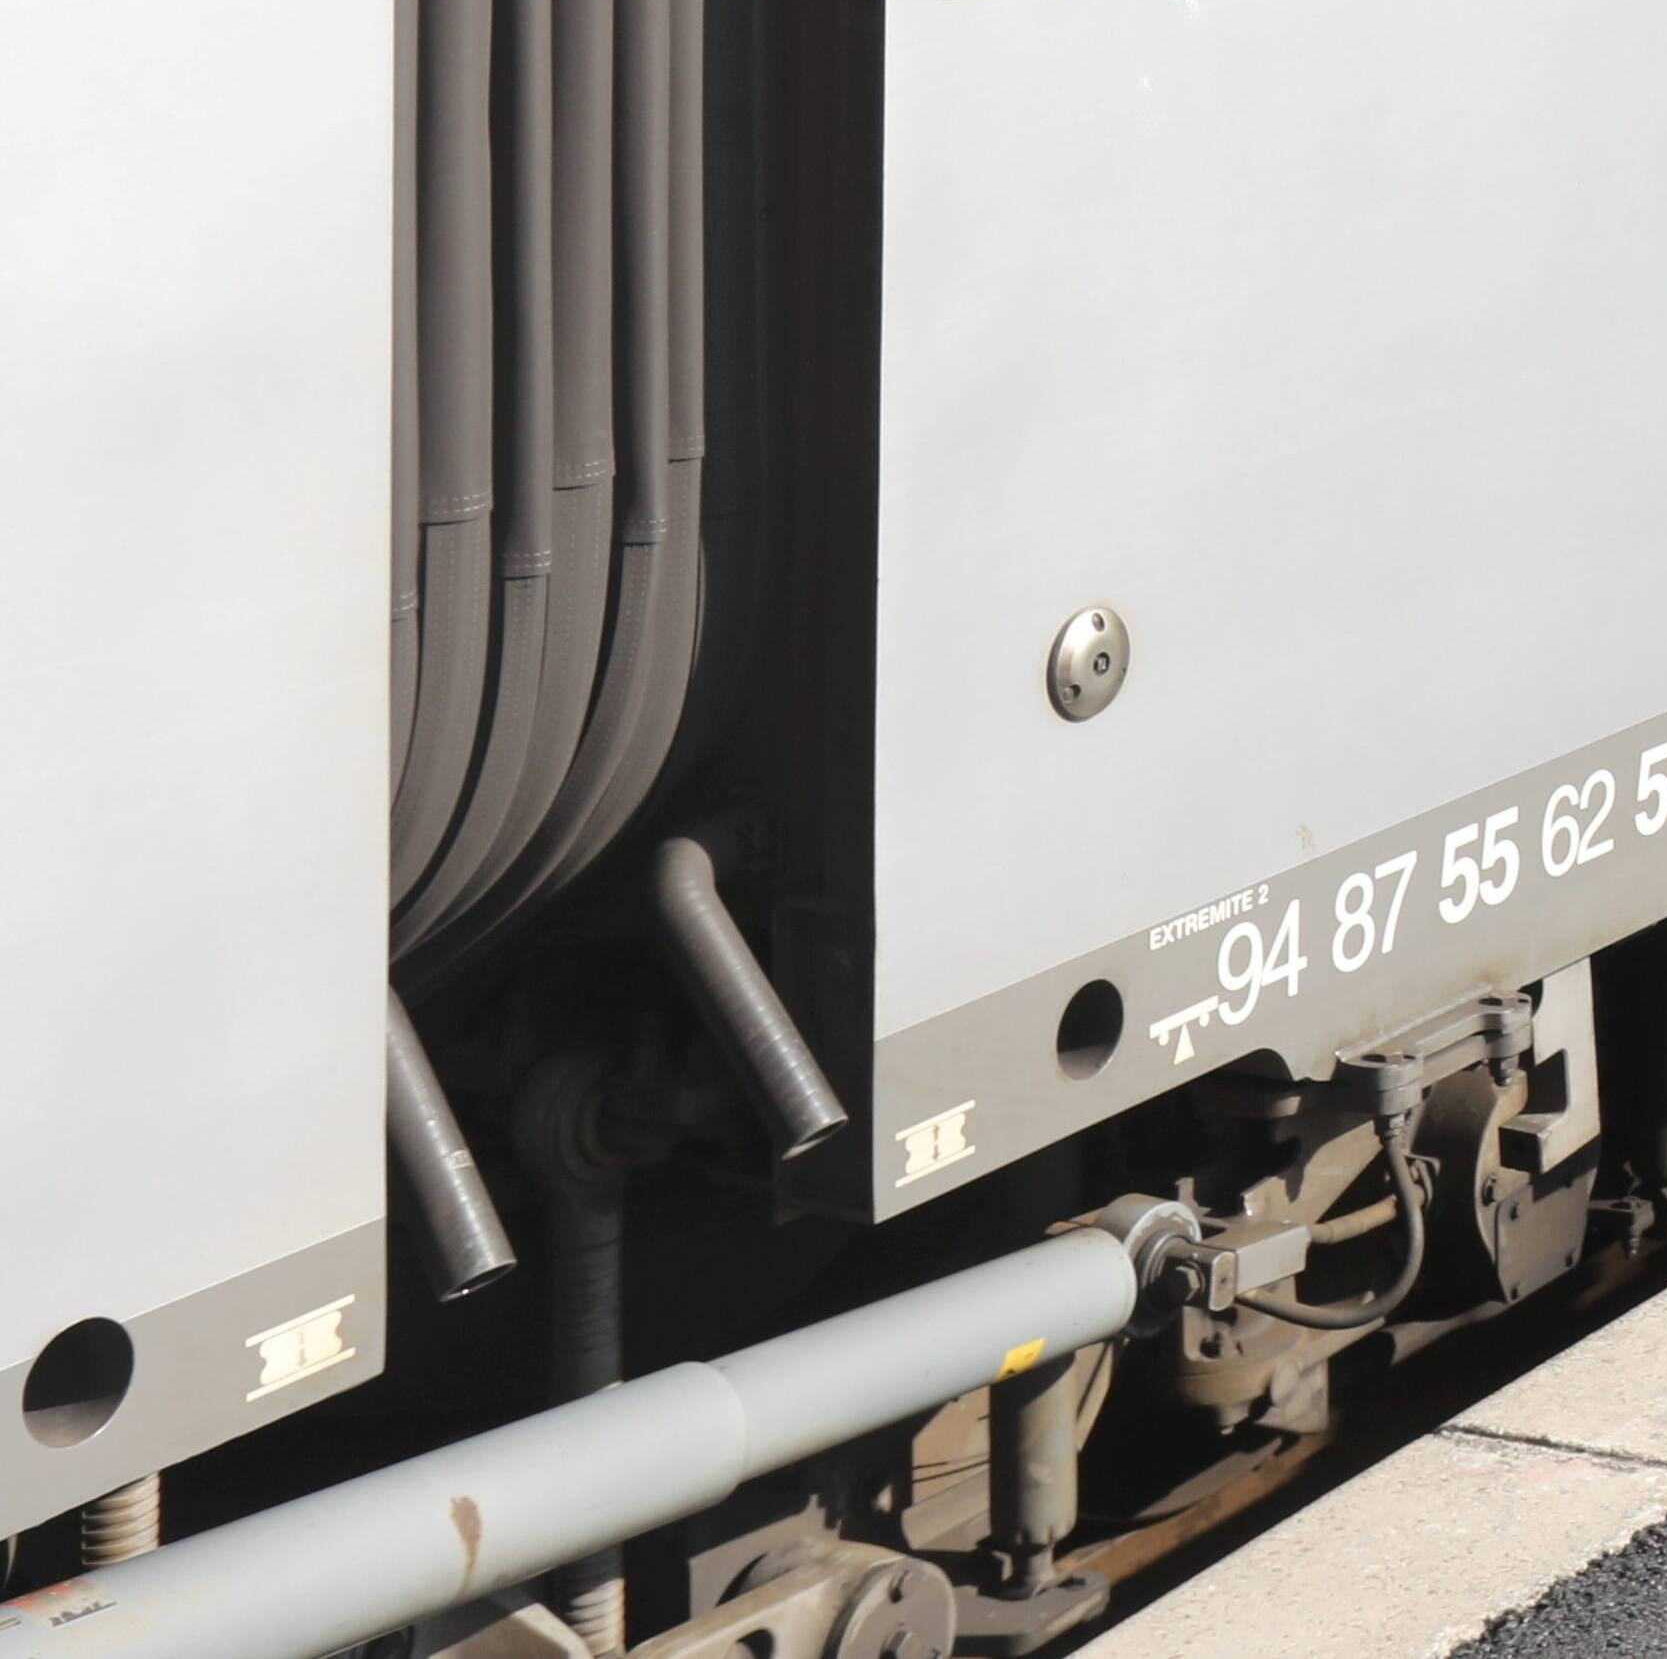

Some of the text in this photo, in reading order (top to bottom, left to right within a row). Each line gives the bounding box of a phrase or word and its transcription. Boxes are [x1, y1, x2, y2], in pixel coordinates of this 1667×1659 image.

[1150, 884, 1269, 951] EXTREMITE 2
[1217, 898, 1308, 1025] 94
[1331, 850, 1418, 974] 87
[1438, 806, 1520, 925] 55
[1541, 768, 1616, 878] 62
